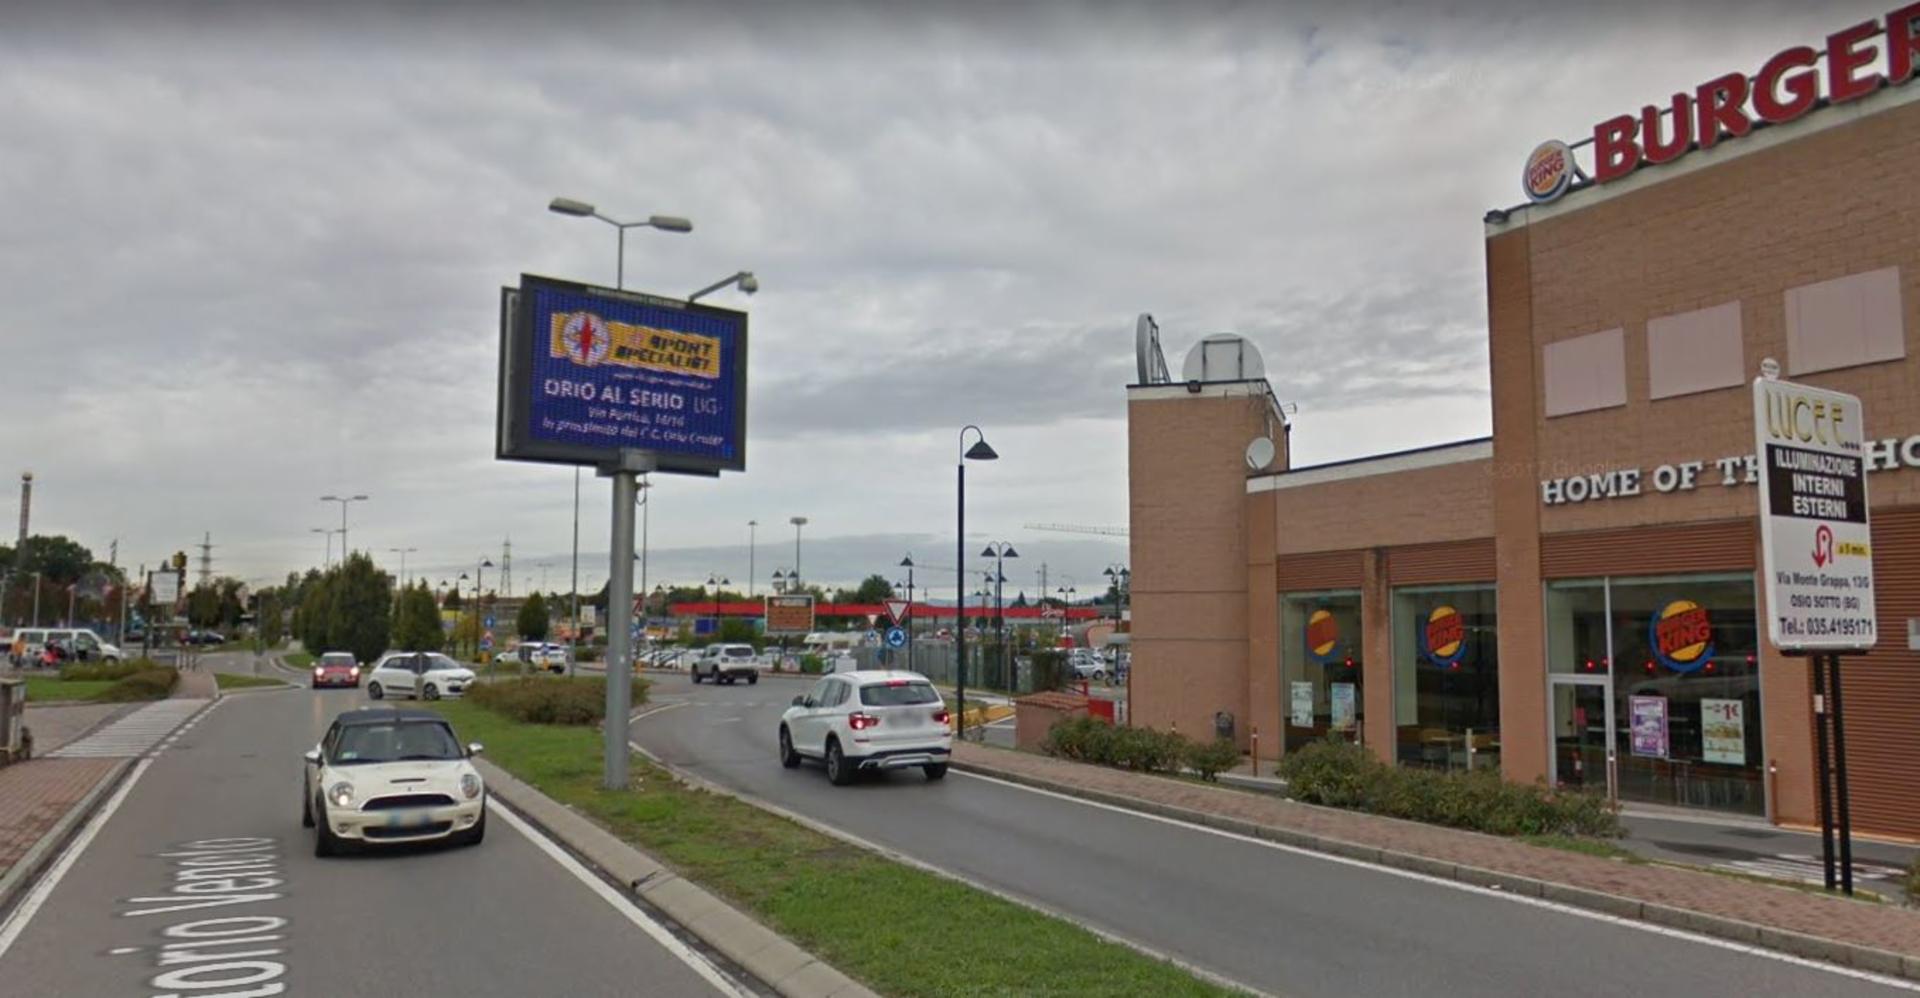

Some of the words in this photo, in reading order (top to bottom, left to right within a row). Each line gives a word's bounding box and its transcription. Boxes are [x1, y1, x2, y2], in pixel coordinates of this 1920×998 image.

[1529, 158, 1565, 189] KING
[614, 345, 710, 371] SPECIALIST
[651, 335, 712, 356] SPORT
[543, 378, 596, 400] ORIO
[601, 385, 625, 404] AL
[629, 388, 684, 410] SERIO
[1765, 388, 1828, 446] LUCE
[1775, 447, 1857, 477] ILLUMINAZIONE
[1540, 468, 1641, 503] HOME
[1653, 460, 1702, 492] OF
[1793, 472, 1845, 498] INTERNI
[1792, 494, 1848, 518] ESTERNI
[1776, 572, 1791, 585] Via
[1792, 573, 1818, 586] Monte
[1791, 594, 1811, 608] OSIO
[1814, 595, 1841, 609] SOTTO
[1842, 596, 1860, 611] (BG)
[1657, 622, 1711, 655] KING
[1806, 617, 1873, 636] 035.4195171
